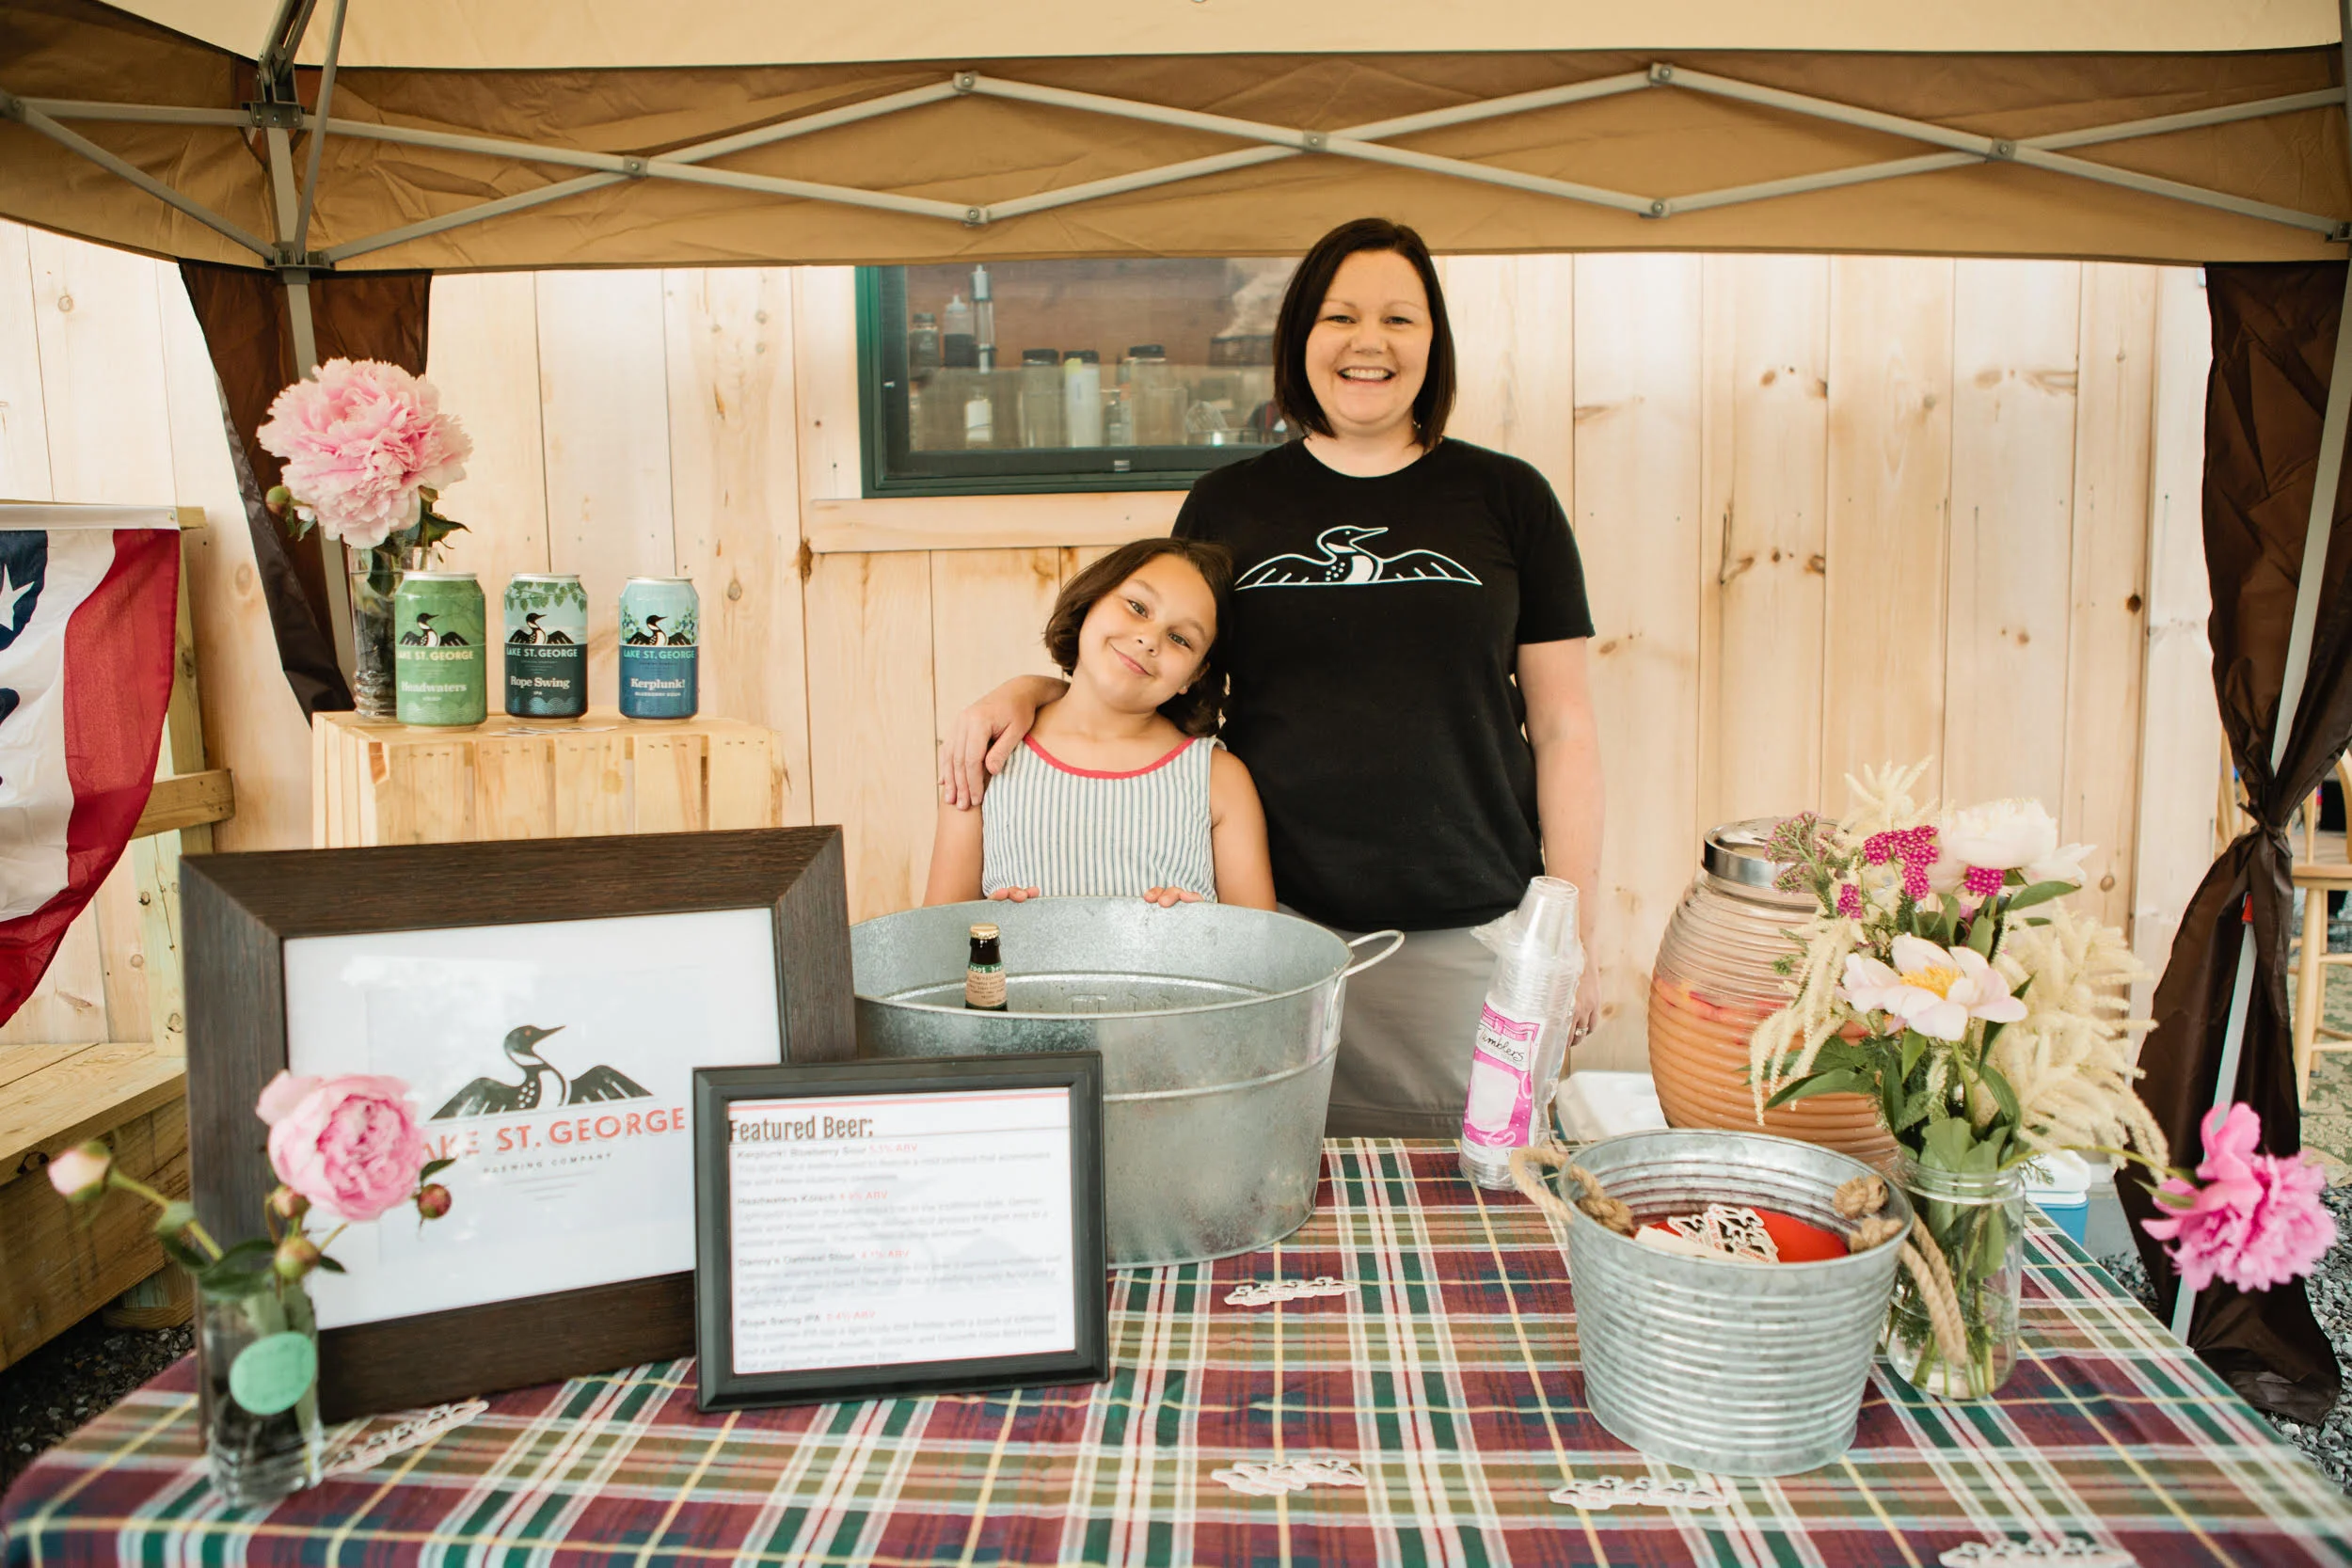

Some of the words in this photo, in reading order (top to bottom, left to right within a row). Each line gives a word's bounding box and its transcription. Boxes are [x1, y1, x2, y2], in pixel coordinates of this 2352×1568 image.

[430, 650, 474, 661] GEORGE
[506, 647, 521, 657] LAKE
[524, 648, 537, 657] ST.
[538, 649, 579, 658] GEORGE
[624, 650, 640, 658] LAKE
[644, 650, 658, 659] ST.
[659, 650, 695, 659] GEORGE
[401, 680, 468, 693] Headwaters
[510, 675, 532, 689] Rope
[533, 677, 571, 689] Swing
[630, 677, 686, 691] Kerplunk!
[422, 1131, 480, 1162] AKE
[497, 1125, 542, 1152] ST.
[549, 1107, 685, 1146] GEORGE
[729, 1115, 816, 1142] Featured
[551, 1152, 612, 1166] COMPANY
[866, 1191, 888, 1200] ABV
